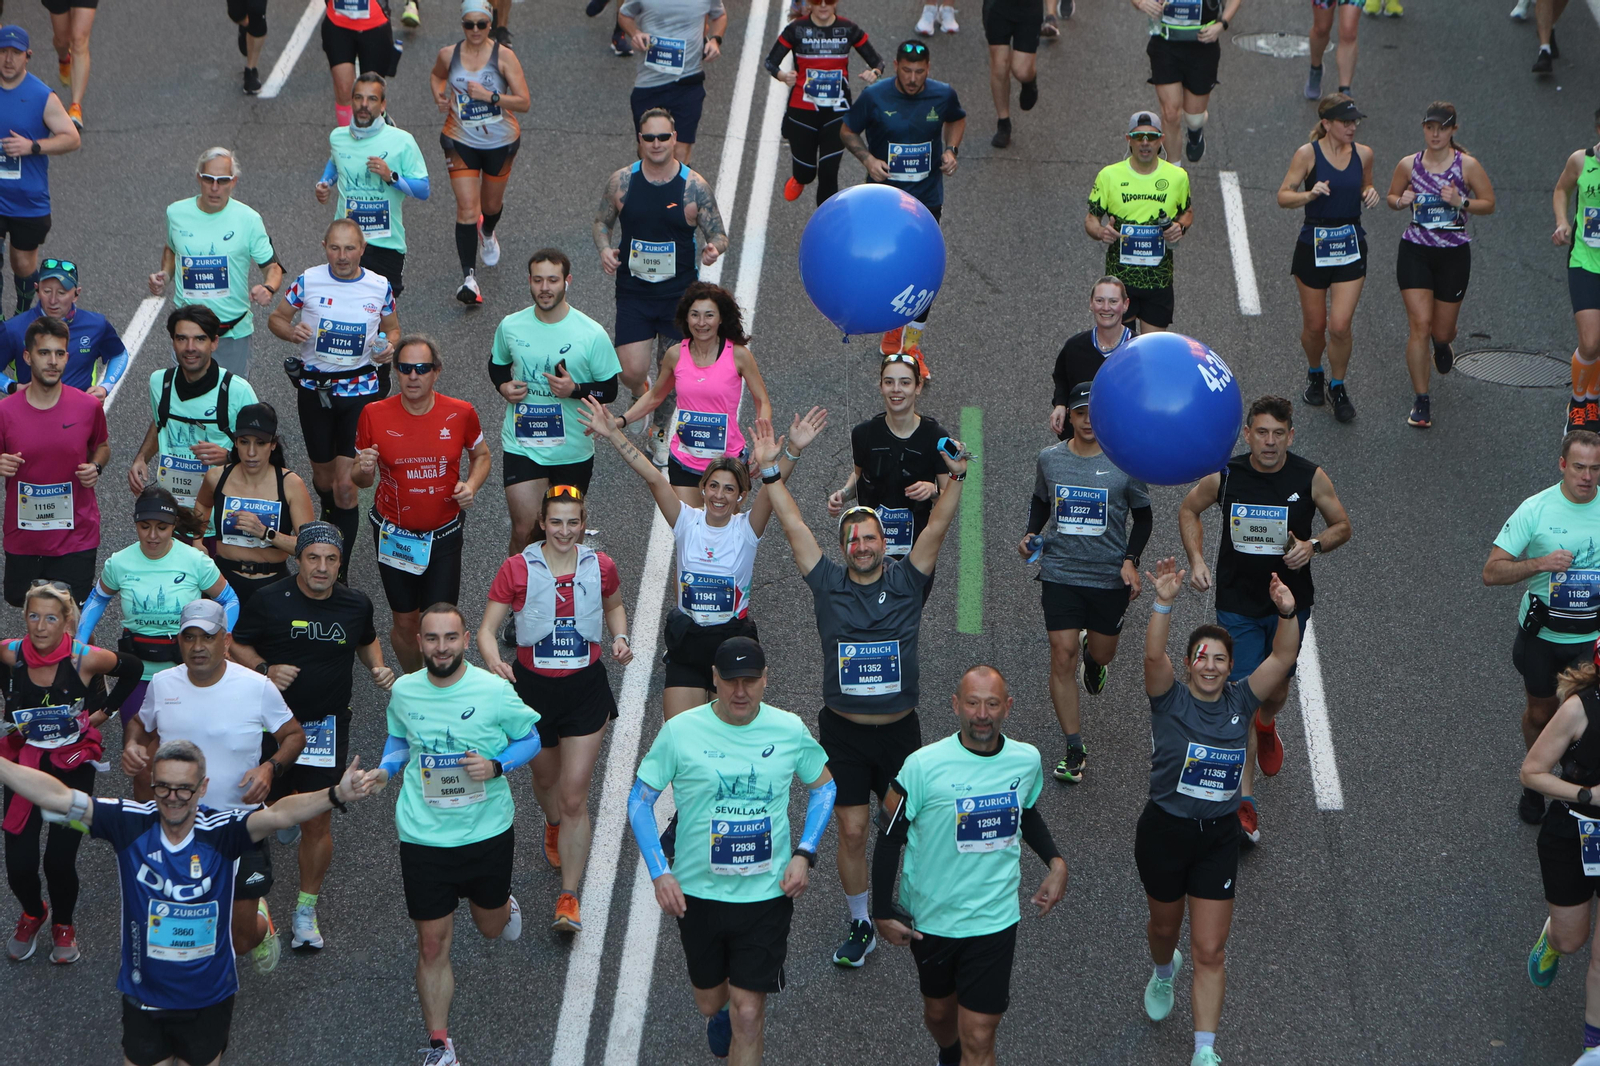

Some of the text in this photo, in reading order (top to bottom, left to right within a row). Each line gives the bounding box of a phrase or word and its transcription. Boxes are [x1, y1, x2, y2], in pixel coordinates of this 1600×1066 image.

[659, 40, 681, 48] ZURICH
[904, 146, 927, 154] ZURICH
[359, 202, 384, 210] ZURICH
[1329, 228, 1351, 238] ZURICH
[195, 259, 222, 267] ZURICH
[642, 257, 661, 265] 10195
[889, 284, 934, 318] 4:30
[335, 323, 362, 332] ZURICH
[331, 337, 352, 347] 11714
[327, 346, 354, 356] FERNAND
[1196, 349, 1234, 393] 4:30
[693, 414, 721, 424] ZURICH
[528, 421, 549, 429] 12029
[690, 430, 711, 439] 12538
[694, 440, 706, 448] EVA
[403, 456, 437, 464] GENERALI
[174, 460, 203, 471] ZURICH
[406, 467, 438, 480] MÁLAGA
[171, 476, 192, 486] 11152
[35, 486, 65, 496] ZURICH
[171, 486, 191, 496] BORJA
[1071, 490, 1101, 500] ZURICH
[34, 502, 56, 511] 11165
[242, 501, 274, 512] ZURICH
[1069, 505, 1091, 514] 12327
[35, 512, 55, 520] JAIME
[883, 512, 909, 520] ZURICH
[1250, 509, 1280, 518] ZURICH
[1058, 515, 1104, 525] BARAKAT AMINE
[1249, 525, 1268, 534] 8839
[1242, 535, 1264, 543] CHEMA
[391, 550, 415, 563] ENRIQUE
[697, 576, 728, 586] ZURICH
[1569, 573, 1600, 581] ZURICH
[694, 592, 716, 601] 11941
[1567, 590, 1591, 598] 11829
[690, 603, 721, 612] MANUELA
[290, 620, 347, 642] FILA
[553, 649, 575, 657] PAOLA
[859, 645, 892, 655] ZURICH
[857, 663, 882, 673] 11352
[858, 675, 883, 684] MARCO
[36, 709, 69, 718] ZURICH
[309, 747, 331, 755] RAPAZ
[1209, 751, 1241, 761] ZURICH
[1202, 767, 1227, 779] 11355
[1198, 778, 1224, 789] FAUSTA
[440, 786, 466, 796] SERGIO
[978, 796, 1011, 808] ZURICH
[732, 822, 766, 833] ZURICH
[976, 816, 1002, 829] 12934
[981, 829, 998, 840] PIER
[730, 842, 757, 852] 12936
[732, 854, 755, 864] RAFFE
[136, 863, 212, 902] DIGI
[172, 907, 210, 917] ZURICH
[171, 926, 195, 937] 3860
[169, 939, 196, 948] JAVIER
